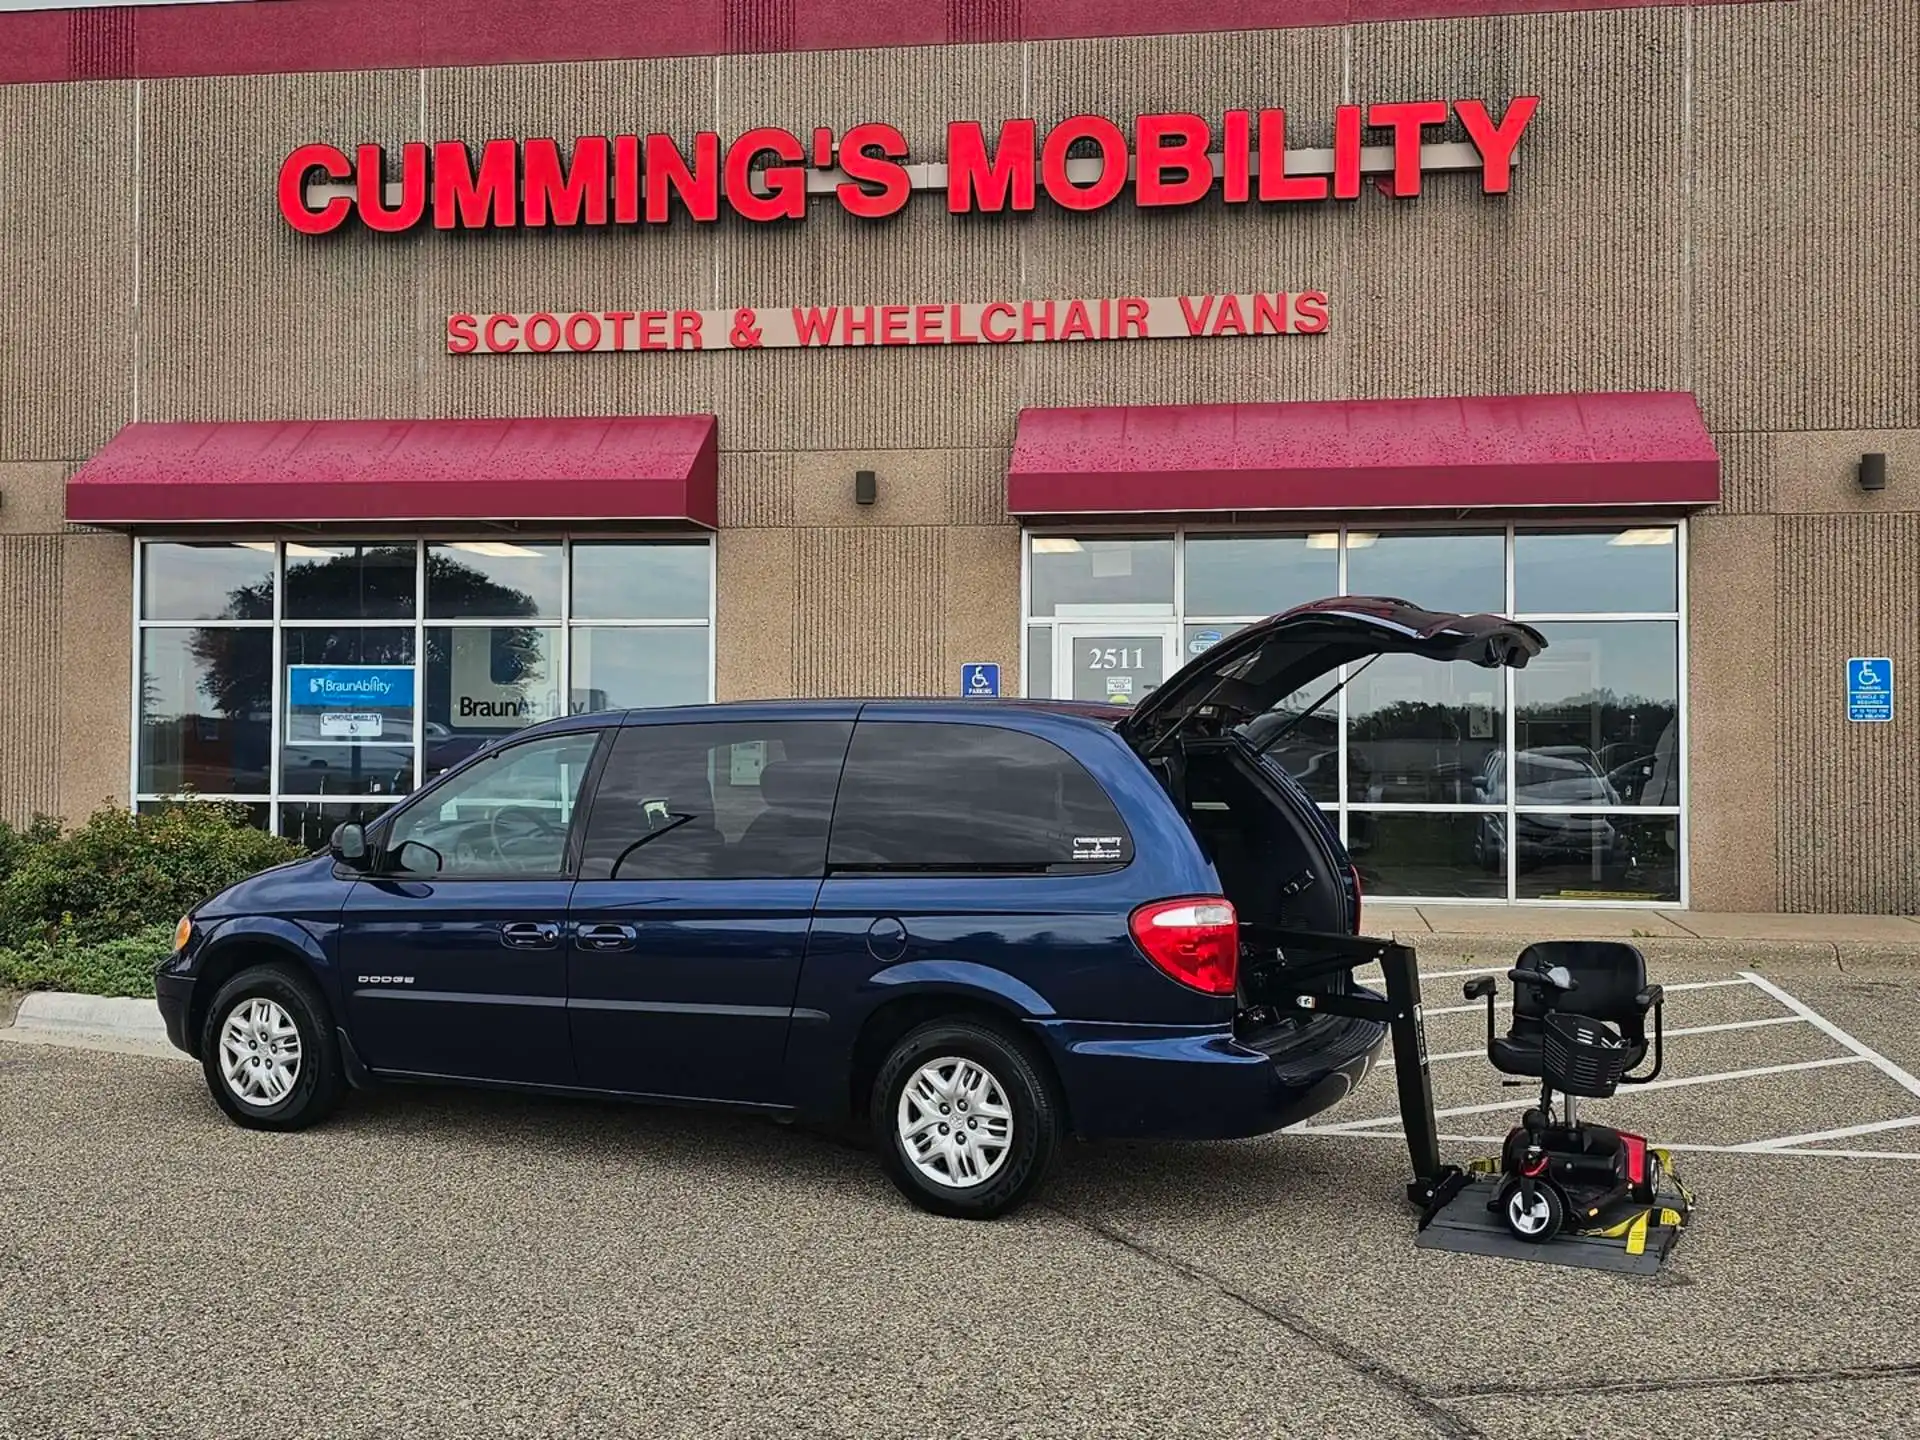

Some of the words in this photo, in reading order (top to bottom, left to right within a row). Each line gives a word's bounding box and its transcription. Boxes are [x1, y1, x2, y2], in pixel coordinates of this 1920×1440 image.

[277, 122, 912, 235] CUMMING'S
[947, 95, 1540, 213] MOBILITY
[448, 309, 703, 353] SCOOTER
[729, 307, 763, 350] &
[791, 298, 1150, 348] WHEELCHAIR
[1180, 291, 1329, 335] VANS
[1088, 647, 1145, 669] 2511
[325, 676, 391, 695] BraunAbility
[458, 689, 585, 715] BraunAbily
[358, 975, 415, 984] DODGE
